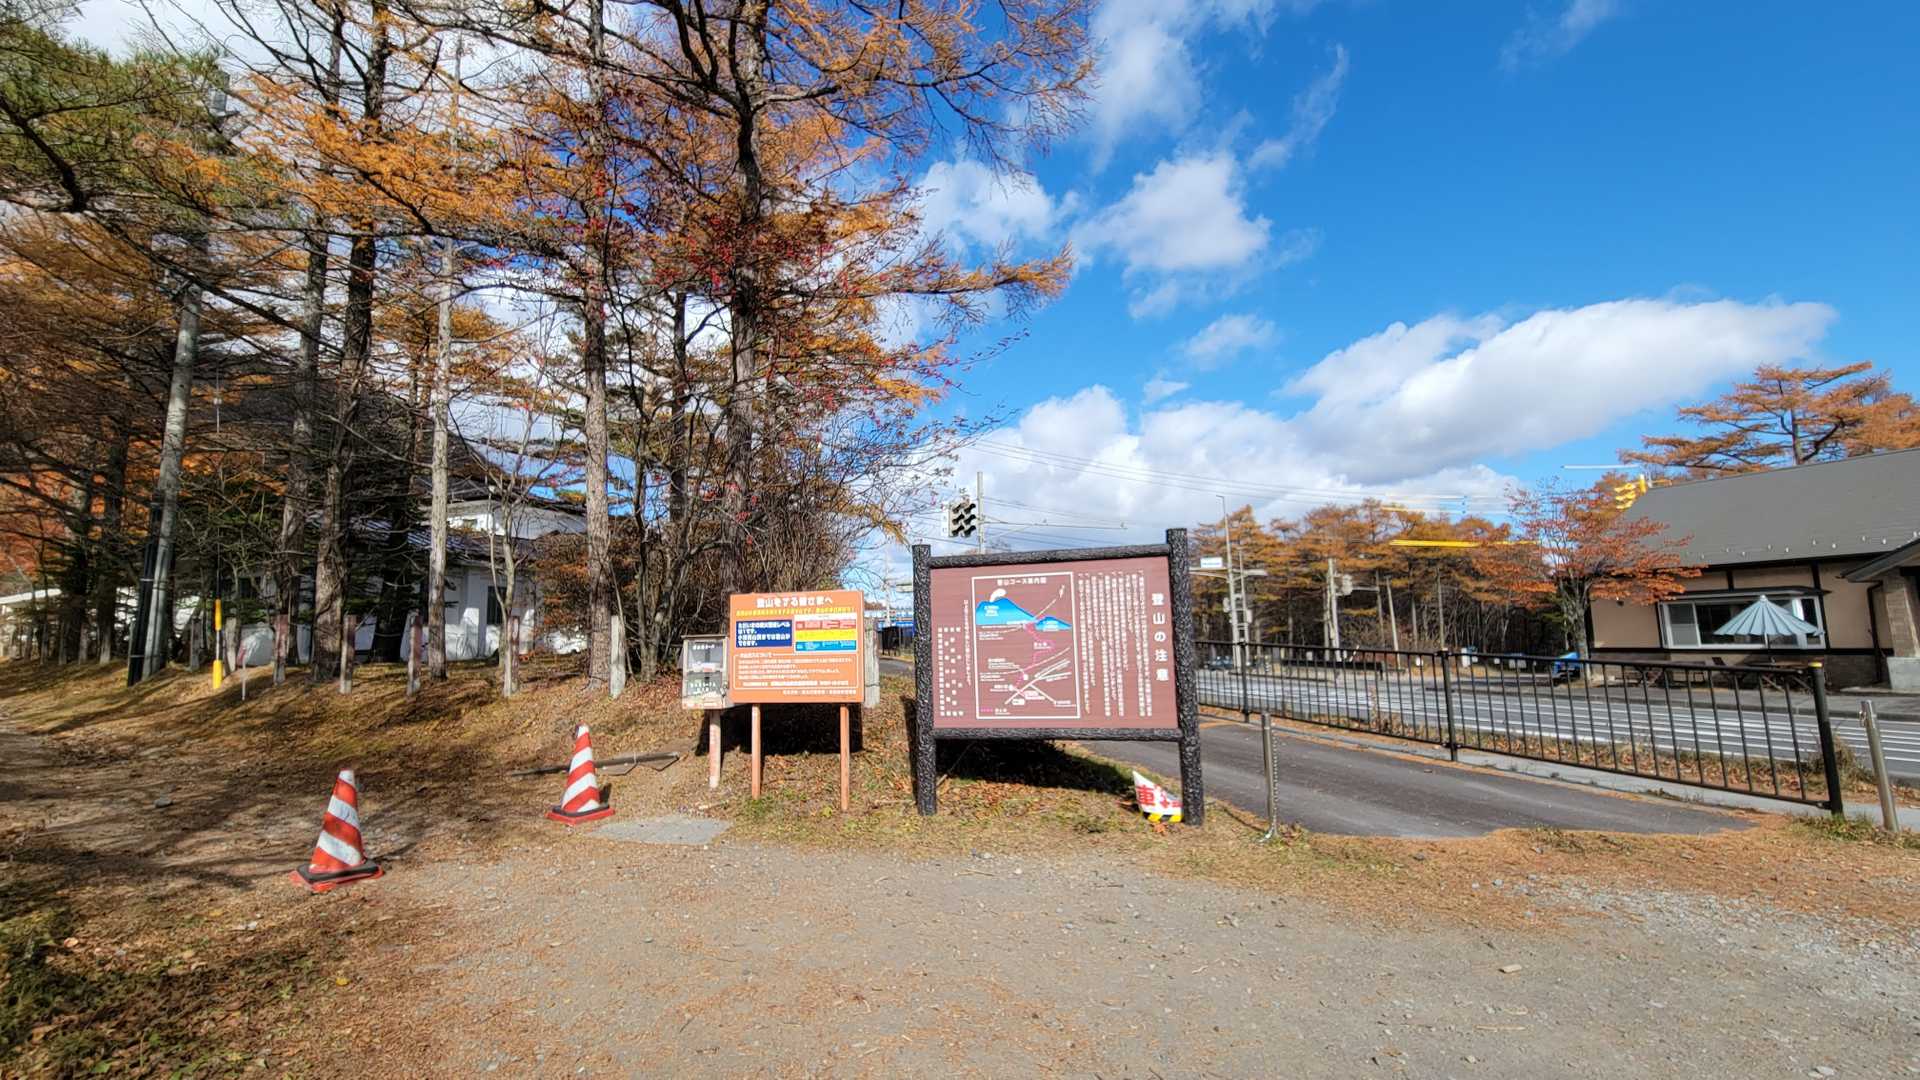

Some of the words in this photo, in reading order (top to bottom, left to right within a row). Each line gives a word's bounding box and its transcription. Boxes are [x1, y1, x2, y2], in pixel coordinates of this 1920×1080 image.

[1151, 592, 1169, 682] 登山の注意
